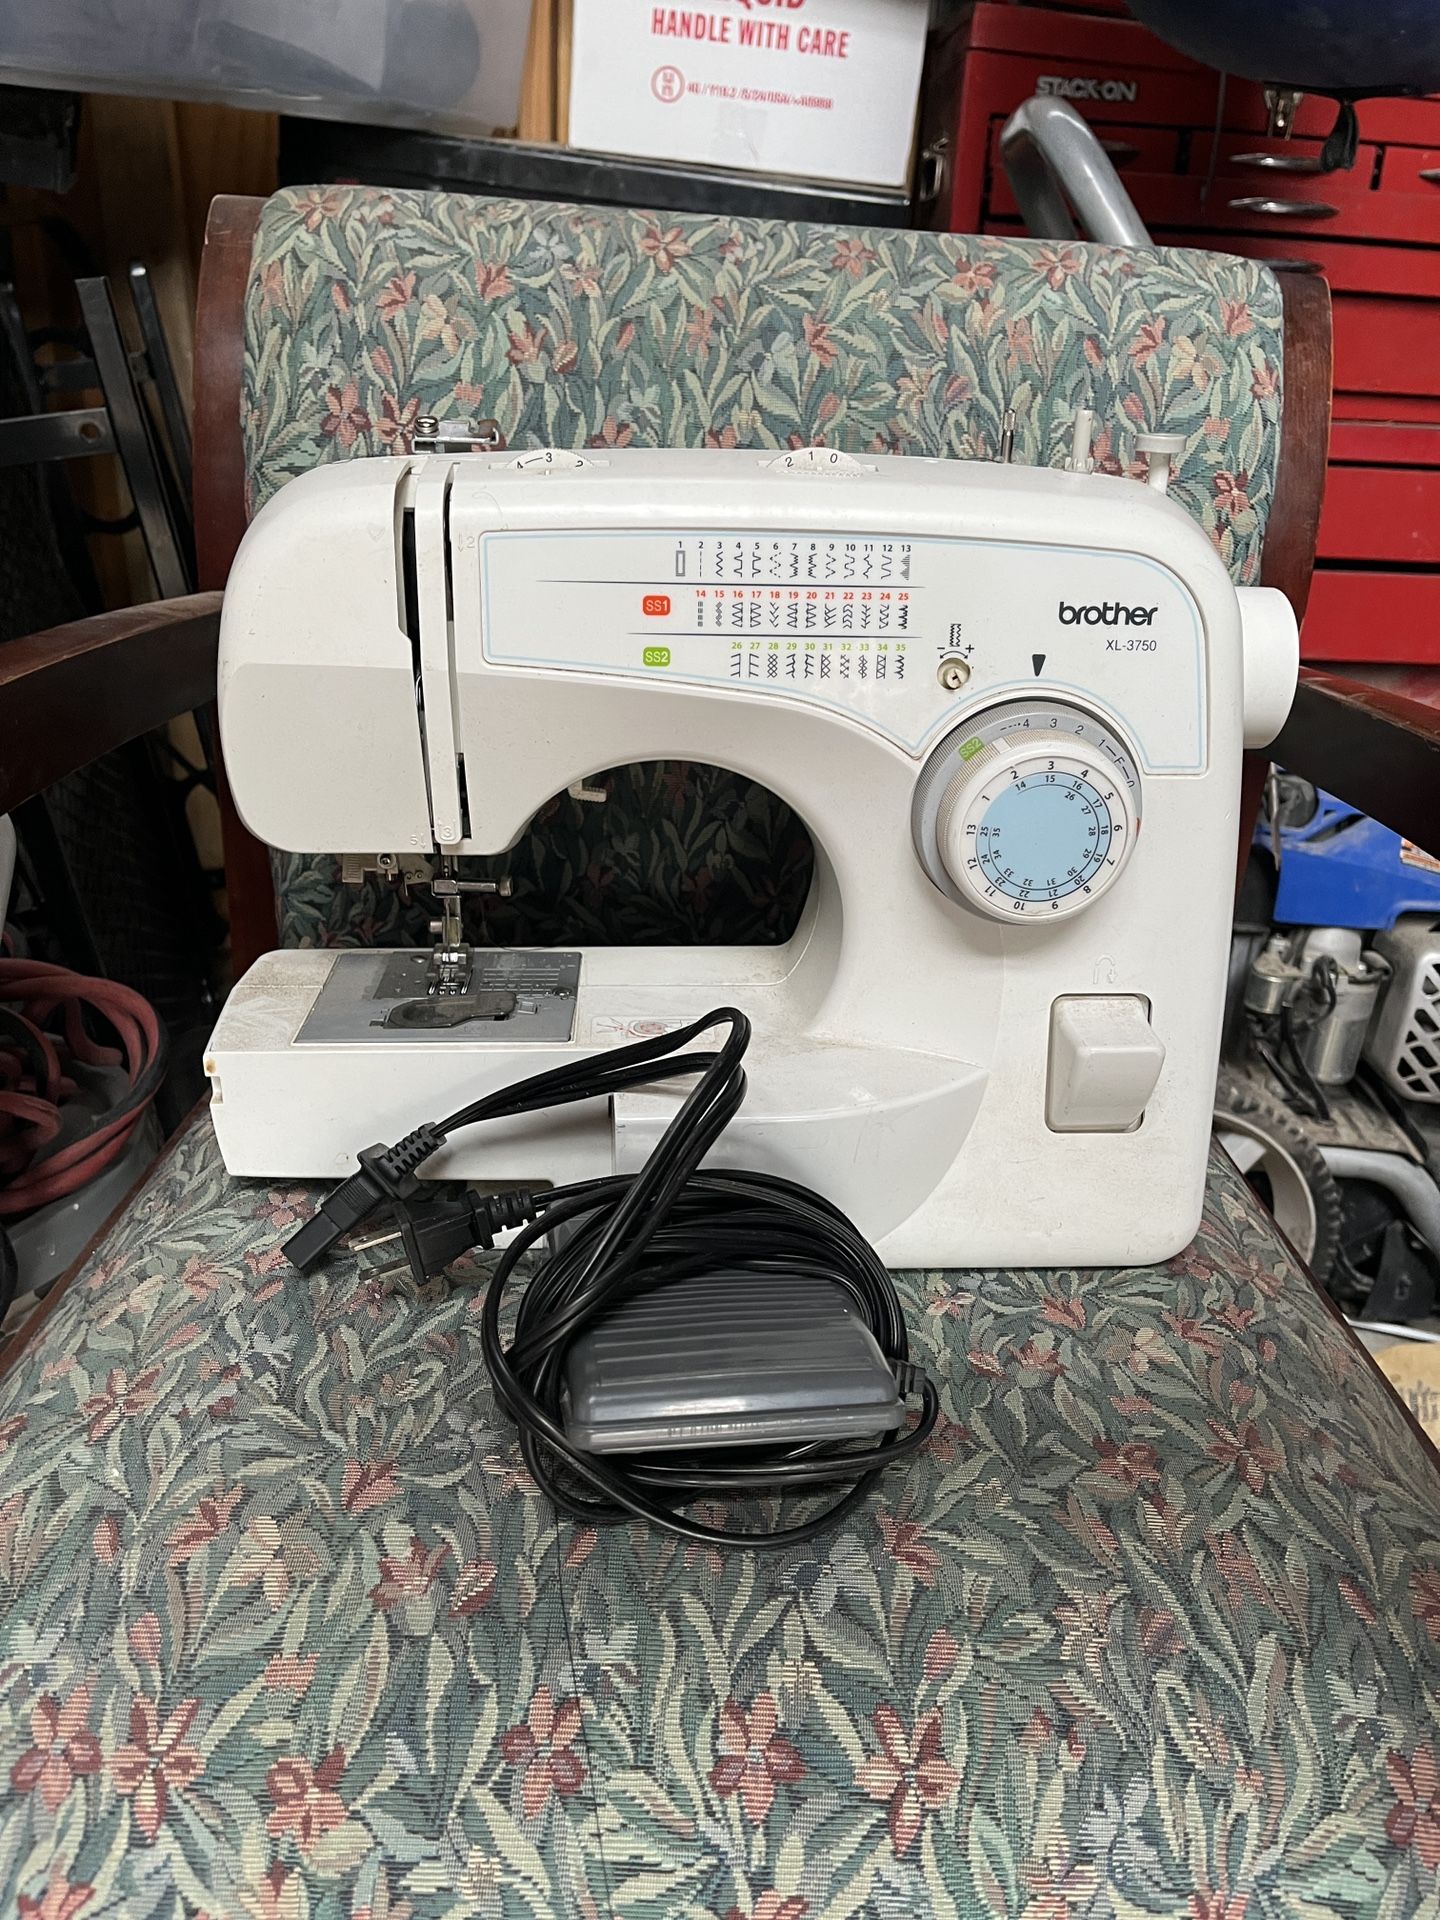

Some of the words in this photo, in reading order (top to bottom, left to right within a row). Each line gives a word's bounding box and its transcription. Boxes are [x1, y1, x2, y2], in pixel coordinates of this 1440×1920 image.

[652, 8, 731, 43] HANDLE
[739, 19, 790, 50] WITH
[797, 27, 850, 58] CARE
[545, 451, 553, 463] 3
[784, 456, 794, 468] 2
[808, 451, 814, 461] 1
[829, 453, 839, 464] 0
[698, 540, 705, 550] 2
[716, 541, 723, 550] 3
[735, 541, 742, 550] 4
[754, 541, 761, 551] 5
[772, 542, 780, 551] 6
[791, 542, 798, 552] 7
[809, 542, 817, 552] 8
[828, 543, 836, 552] 9
[845, 543, 857, 553] 10
[863, 543, 874, 553] 11
[882, 543, 894, 553] 12
[900, 543, 912, 553] 13
[695, 589, 707, 598] 14
[713, 589, 725, 599] 15
[732, 590, 744, 599] 16
[750, 590, 762, 599] 17
[769, 590, 781, 600] 18
[787, 591, 800, 600] 19
[805, 591, 818, 600] 20
[824, 591, 836, 600] 21
[842, 591, 855, 601] 22
[861, 591, 873, 601] 23
[879, 592, 892, 601] 24
[897, 592, 910, 601] 25
[645, 599, 669, 613] SS1
[1059, 601, 1158, 626] brother
[730, 641, 743, 650] 26
[749, 642, 761, 650] 27
[767, 642, 780, 650] 28
[785, 642, 798, 651] 29
[804, 642, 816, 651] 30
[822, 643, 834, 651] 31
[840, 643, 852, 651] 32
[858, 643, 871, 652] 33
[876, 643, 889, 652] 34
[894, 643, 907, 652] 35
[1105, 639, 1158, 652] XL-3750
[644, 650, 670, 663] SS2
[1022, 718, 1030, 728] 4
[1049, 718, 1058, 729] 3
[1074, 724, 1084, 735] 2
[960, 738, 983, 758] SS2
[1047, 760, 1055, 771] 3
[1010, 770, 1019, 780] 2
[1045, 775, 1056, 783] 15
[1080, 769, 1089, 778] 4
[1015, 780, 1026, 791] 14
[1072, 780, 1083, 791] 16
[981, 794, 991, 802] 1
[1064, 791, 1075, 801] 26
[1104, 791, 1114, 800] 5
[1092, 799, 1103, 808] 17
[1081, 805, 1092, 815] 27
[966, 824, 977, 836] 13
[980, 826, 989, 837] 25
[992, 827, 1001, 837] 35
[1088, 826, 1096, 837] 28
[1101, 825, 1109, 835] 18
[1113, 824, 1123, 832] 6
[981, 853, 991, 865] 24
[993, 849, 1002, 860] 34
[1082, 848, 1092, 859] 29
[1093, 853, 1103, 863] 19
[967, 857, 978, 870] 12
[1106, 858, 1116, 866] 7
[1003, 867, 1015, 878] 33
[1067, 866, 1078, 877] 30
[994, 876, 1006, 888] 23
[1022, 878, 1034, 887] 32
[1046, 877, 1057, 886] 31
[1074, 875, 1086, 886] 20
[984, 885, 996, 897] 11
[1019, 889, 1031, 898] 22
[1048, 888, 1059, 898] 21
[1083, 885, 1092, 894] 8
[1013, 901, 1026, 911] 10
[1051, 901, 1059, 910] 9
